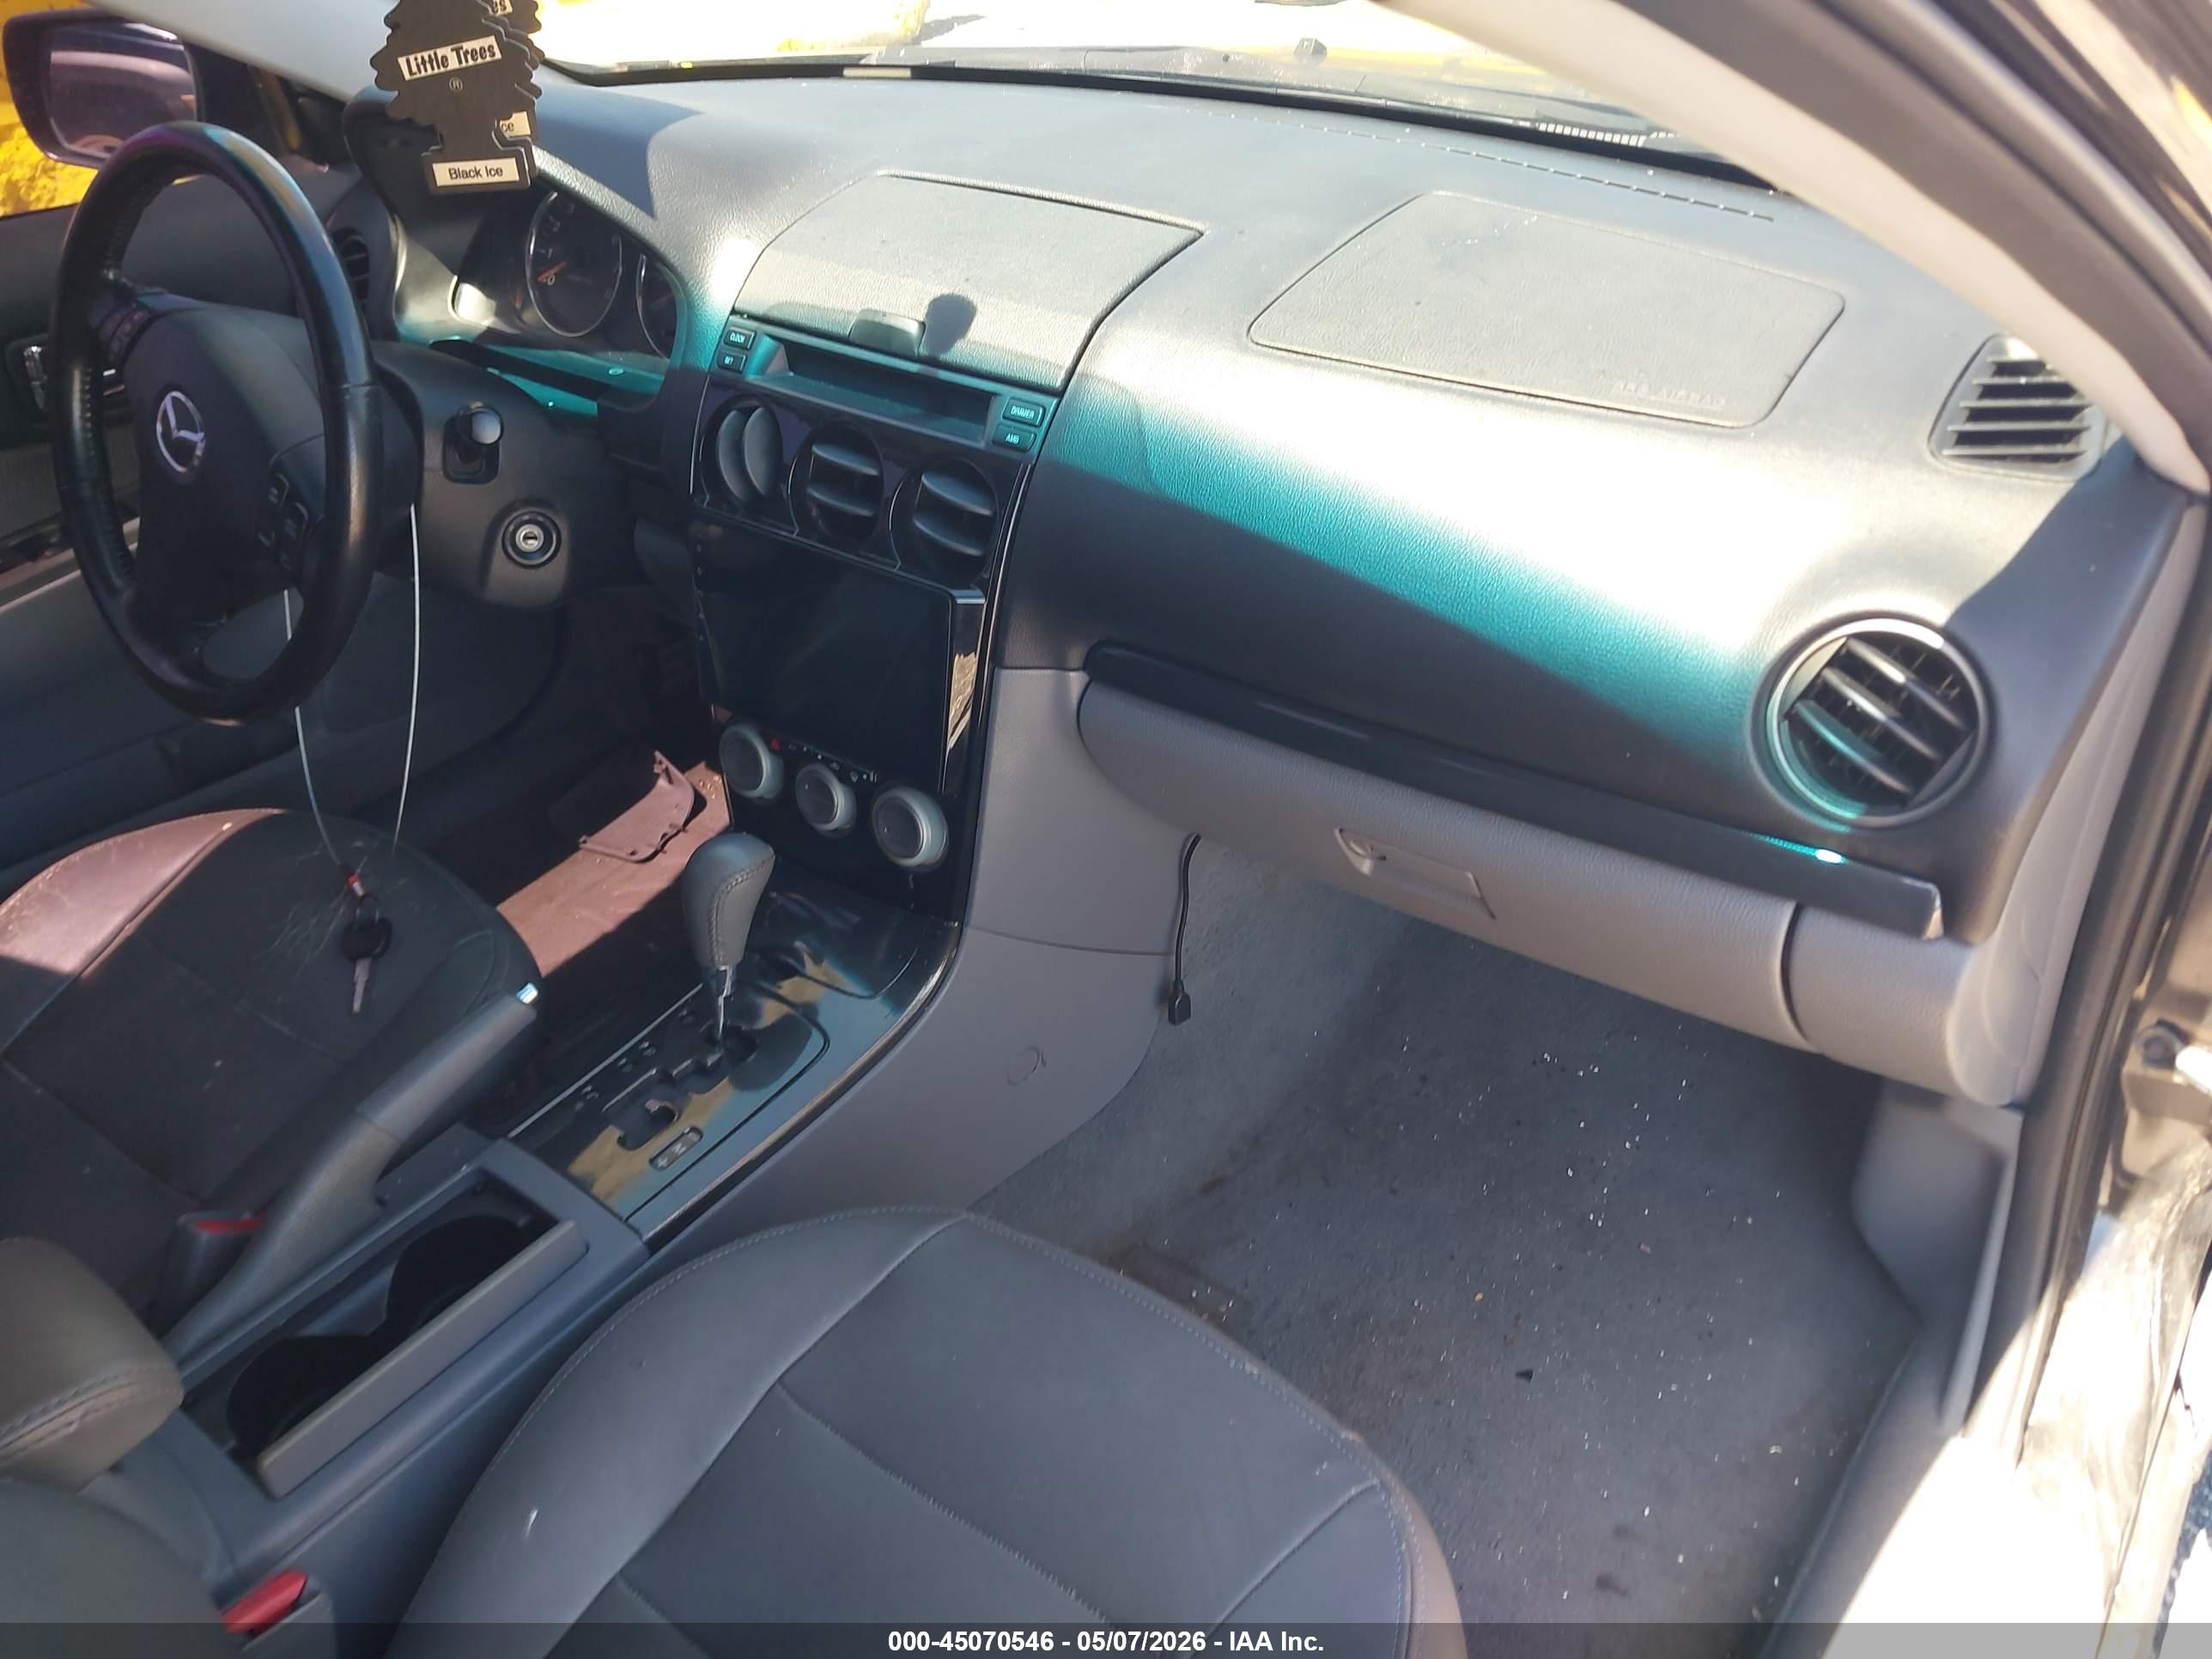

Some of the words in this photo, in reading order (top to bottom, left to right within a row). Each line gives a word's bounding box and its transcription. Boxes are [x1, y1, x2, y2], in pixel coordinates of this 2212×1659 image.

[405, 54, 449, 77] Little
[451, 45, 496, 66] Trees
[500, 121, 515, 132] ce
[447, 167, 483, 180] Black
[485, 166, 504, 178] Ice
[1010, 405, 1035, 420] DIMMER
